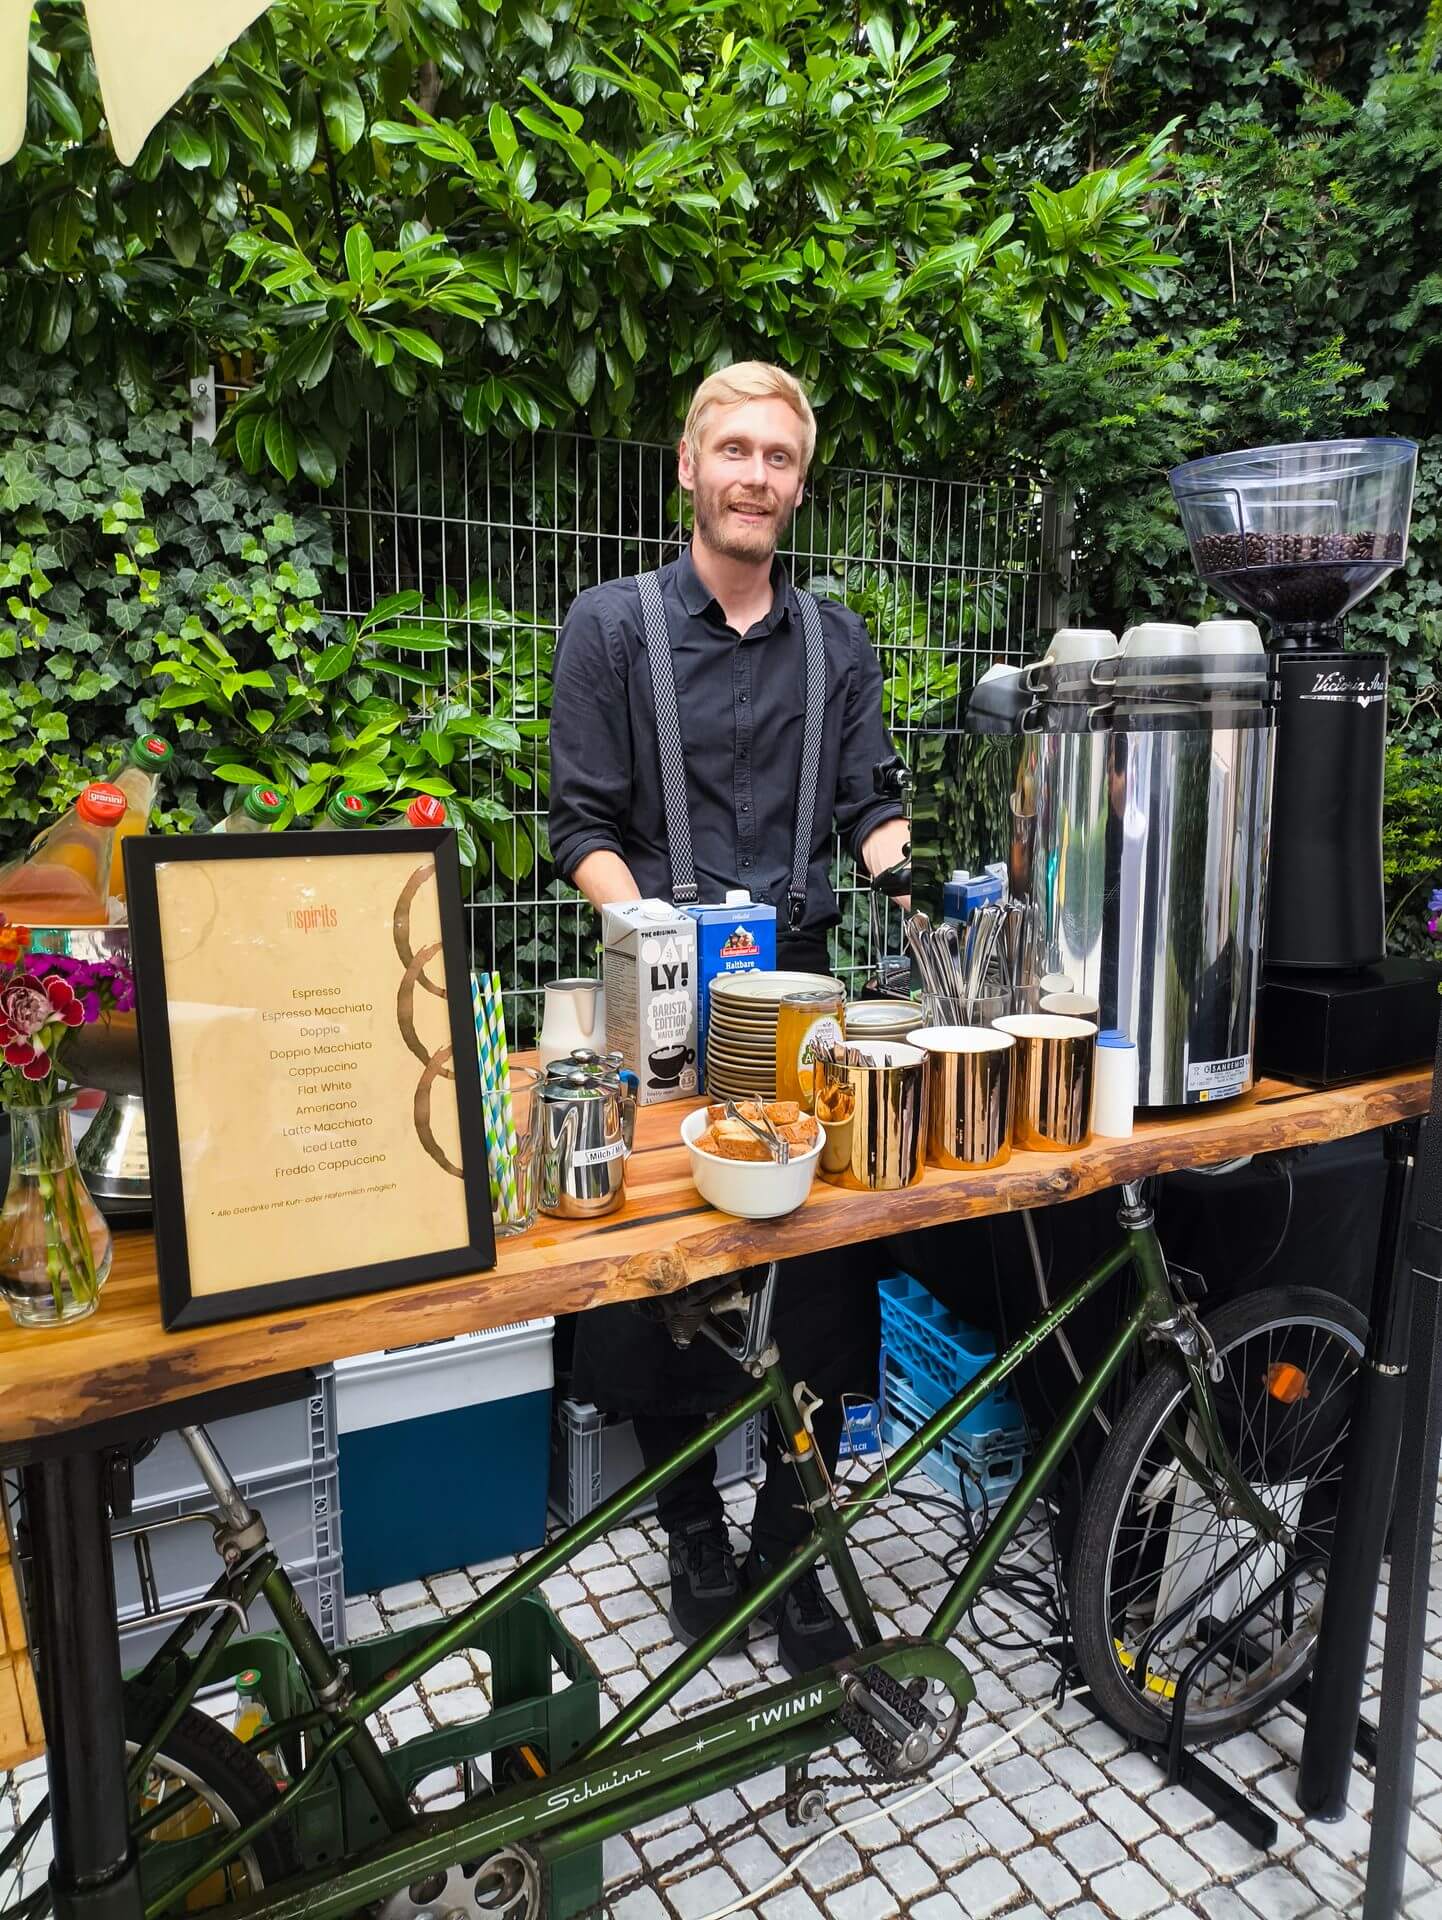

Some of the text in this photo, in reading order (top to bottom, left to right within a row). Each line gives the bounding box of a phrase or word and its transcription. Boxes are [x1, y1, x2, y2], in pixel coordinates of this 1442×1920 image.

[1311, 671, 1365, 692] Victoria
[287, 904, 338, 934] inspirits
[652, 929, 677, 937] ORIGINAL
[725, 960, 755, 970] Haltbare
[650, 962, 689, 991] LY!
[292, 986, 341, 1000] Espresso
[262, 1002, 373, 1023] Espresso Macchiato
[652, 1000, 687, 1018] BARISTA
[300, 1024, 341, 1038] Doppio
[654, 1014, 687, 1031] EDITION
[269, 1040, 373, 1061] Doppio Macchiato
[288, 1061, 358, 1079] Cappuccino
[1211, 1059, 1244, 1073] SANREMO
[297, 1080, 353, 1096] Flat White
[296, 1099, 358, 1116] Americano
[282, 1116, 373, 1137] Latte Macchiato
[302, 1137, 358, 1154] Iced Latte
[589, 1150, 611, 1161] Milch
[274, 1152, 386, 1178] Freddo Cappuccino
[271, 1199, 284, 1209] mit
[746, 1688, 823, 1733] TWINN
[534, 1767, 651, 1820] Schwinn
